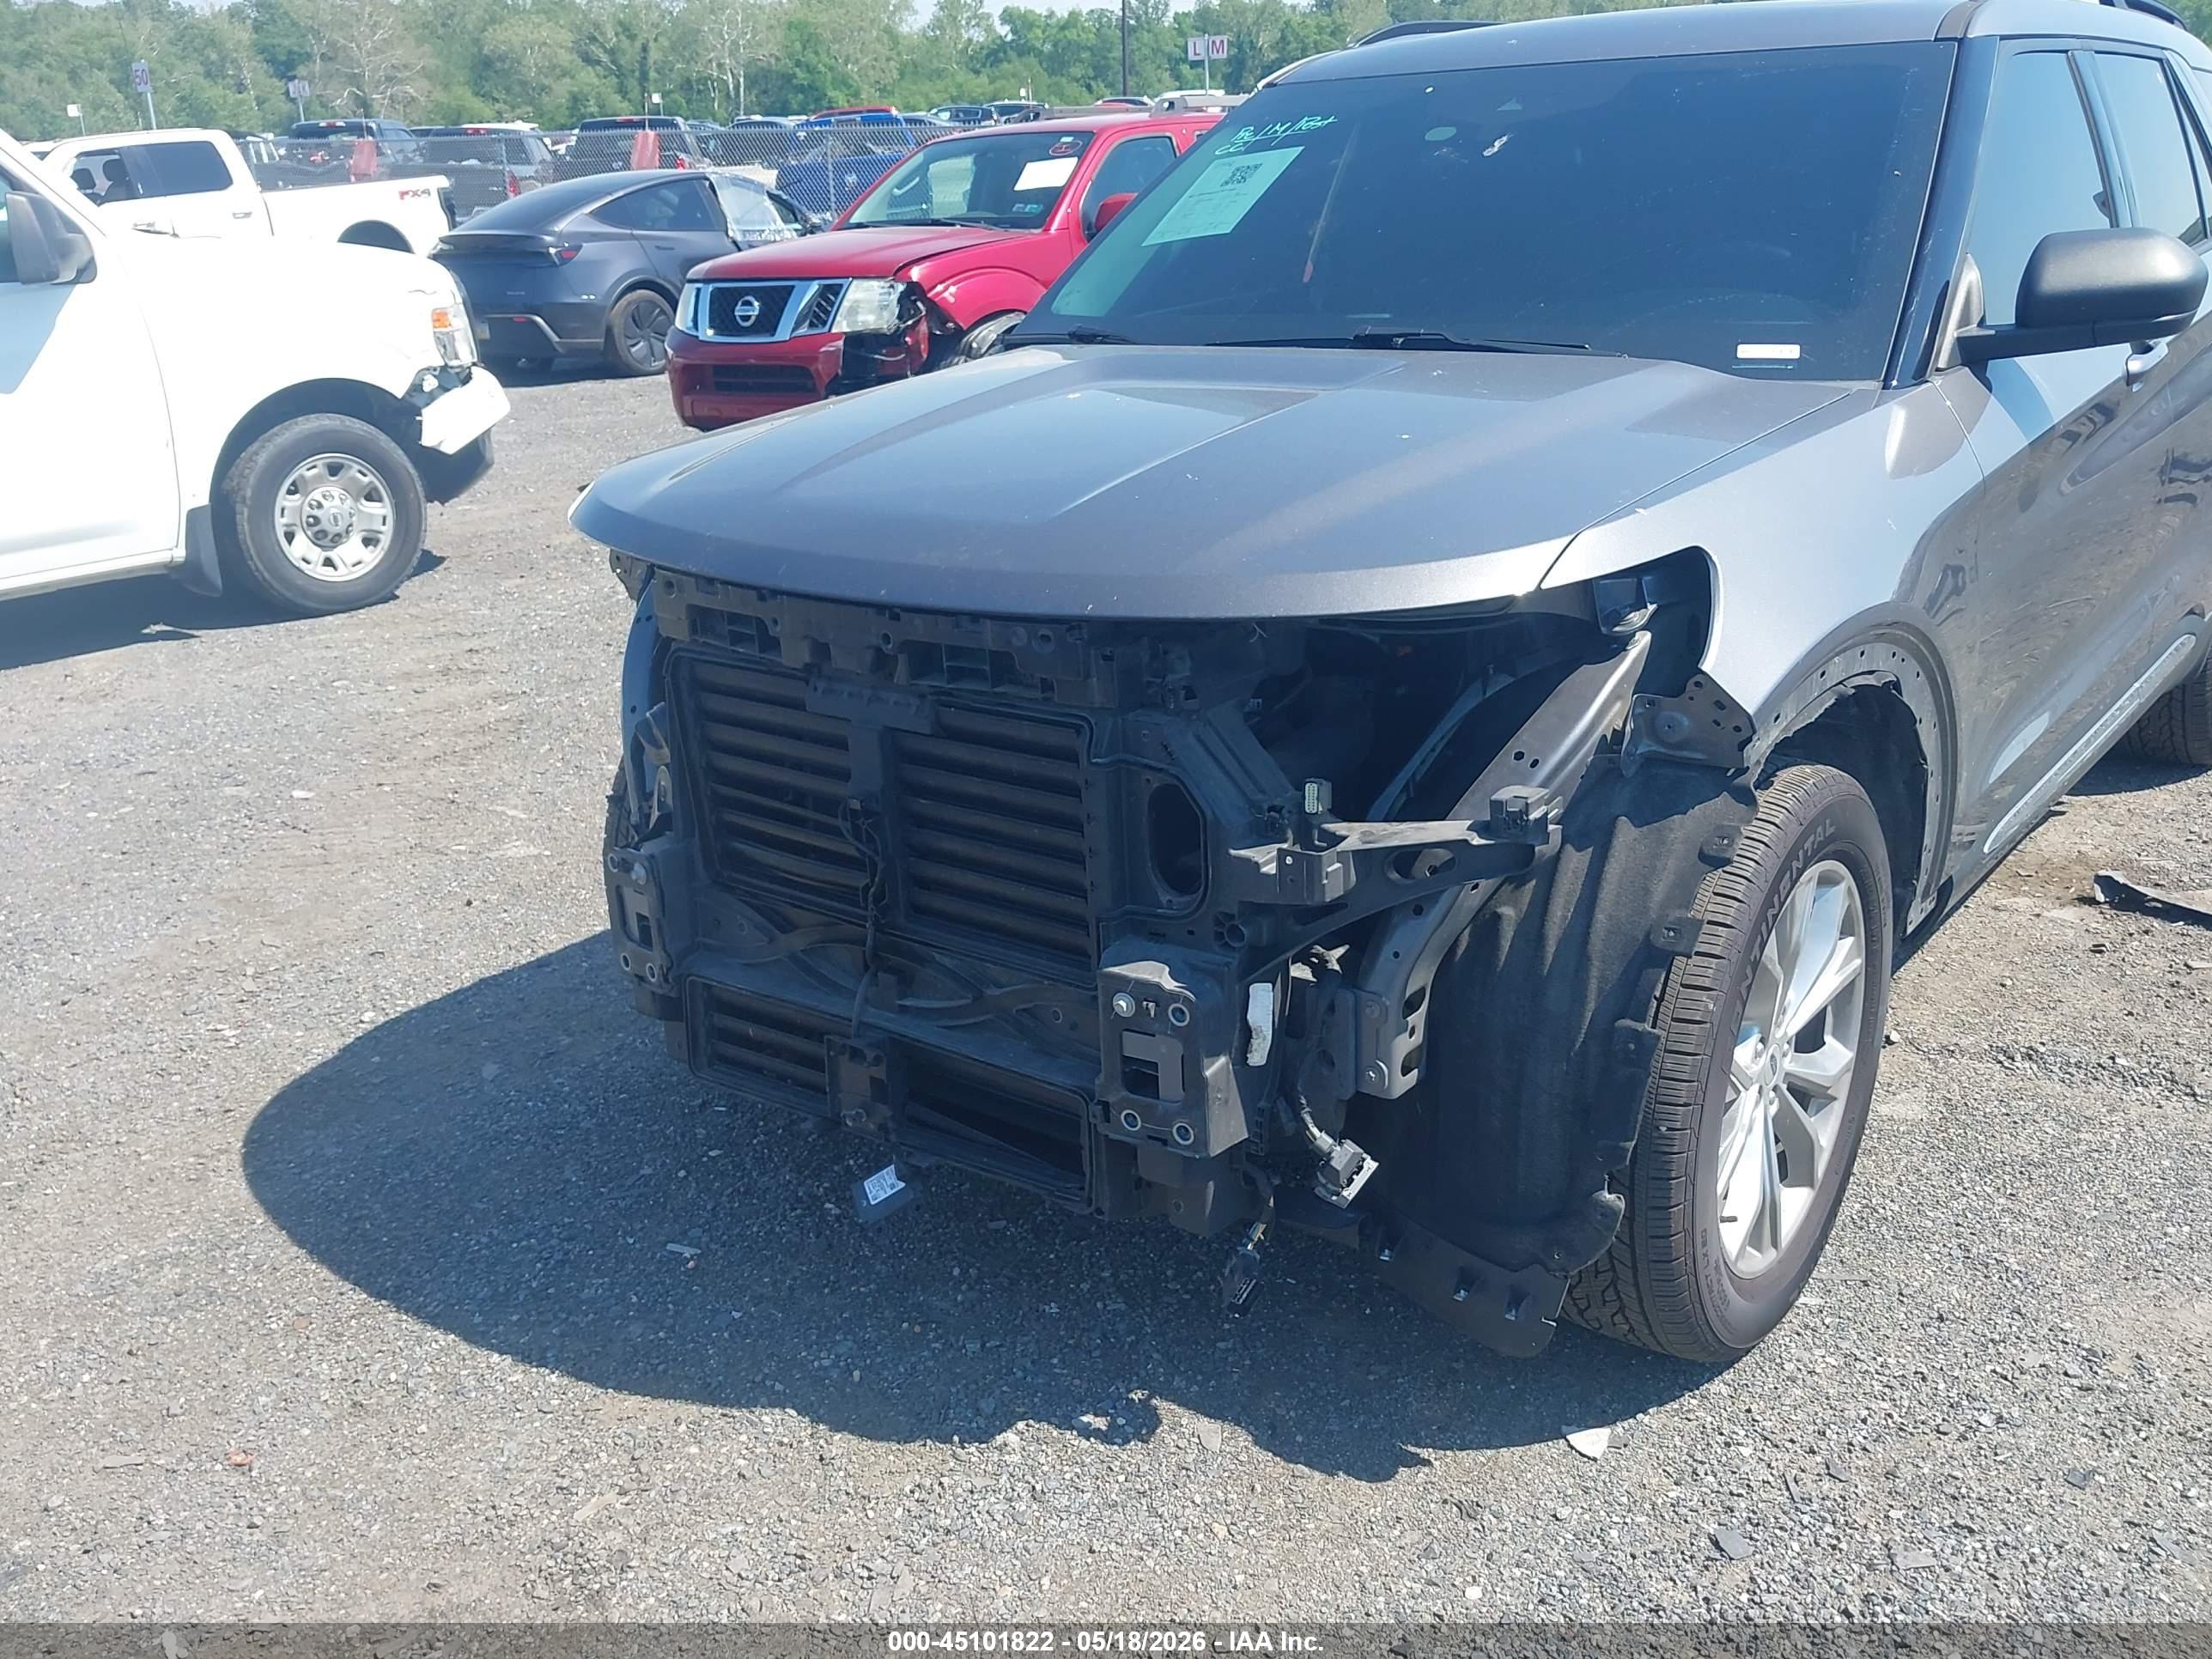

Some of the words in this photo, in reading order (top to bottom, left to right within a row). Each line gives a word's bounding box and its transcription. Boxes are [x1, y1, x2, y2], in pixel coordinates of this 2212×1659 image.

[1194, 41, 1201, 56] L
[1211, 40, 1224, 55] M
[134, 68, 149, 87] 50
